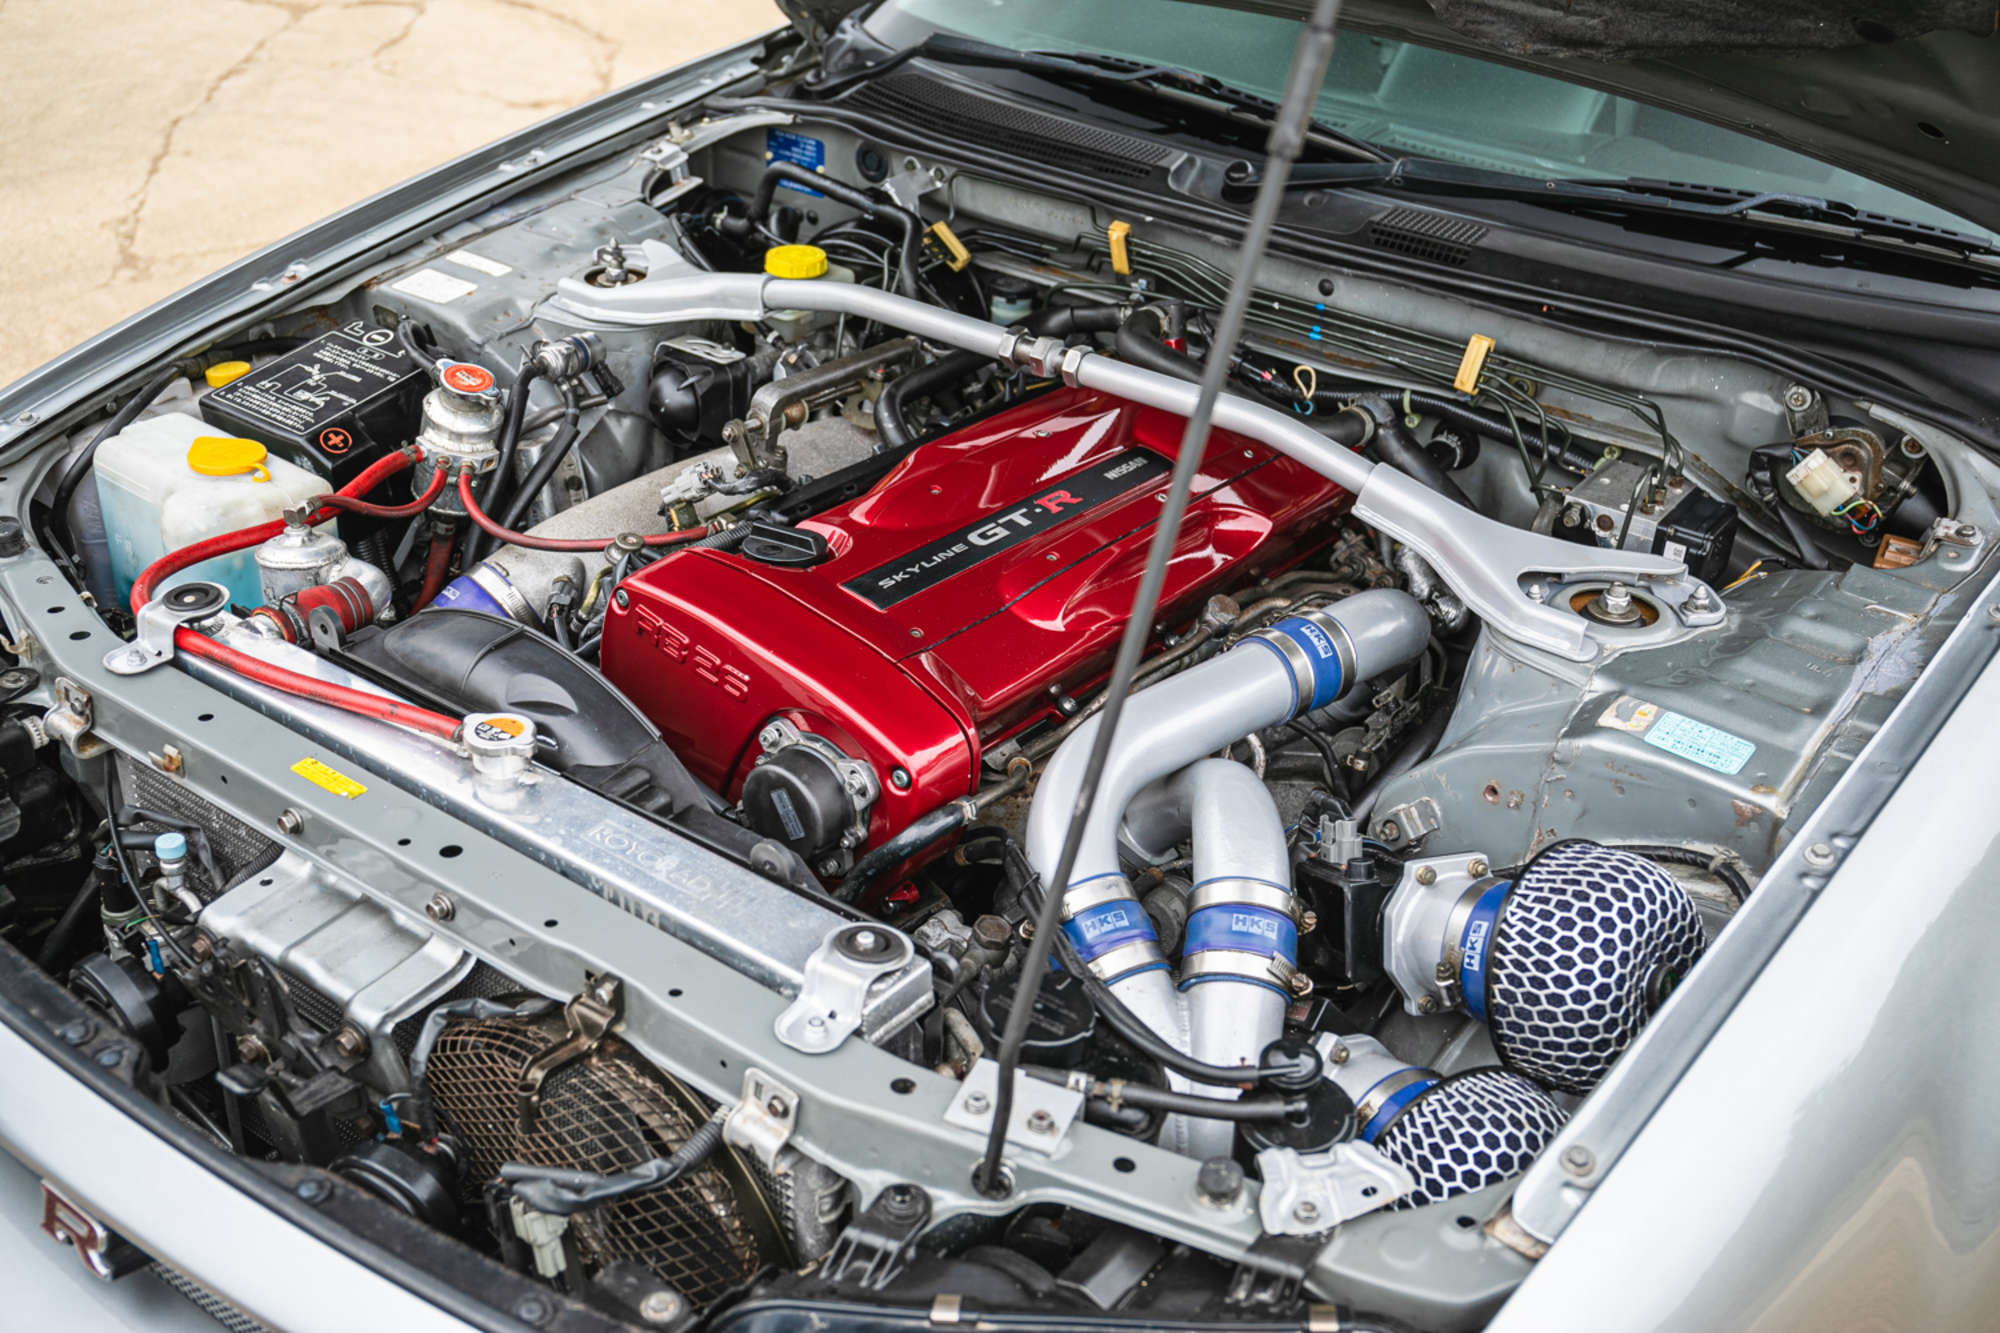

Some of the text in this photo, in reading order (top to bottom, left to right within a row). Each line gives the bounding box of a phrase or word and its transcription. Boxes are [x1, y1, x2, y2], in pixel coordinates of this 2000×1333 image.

[1102, 456, 1149, 481] NISSAN
[877, 542, 969, 590] SKYLINE
[1303, 624, 1333, 657] HKS
[1083, 910, 1128, 937] HKS
[1233, 913, 1278, 938] HKS
[1464, 921, 1488, 970] HKS
[41, 1180, 110, 1281] R
